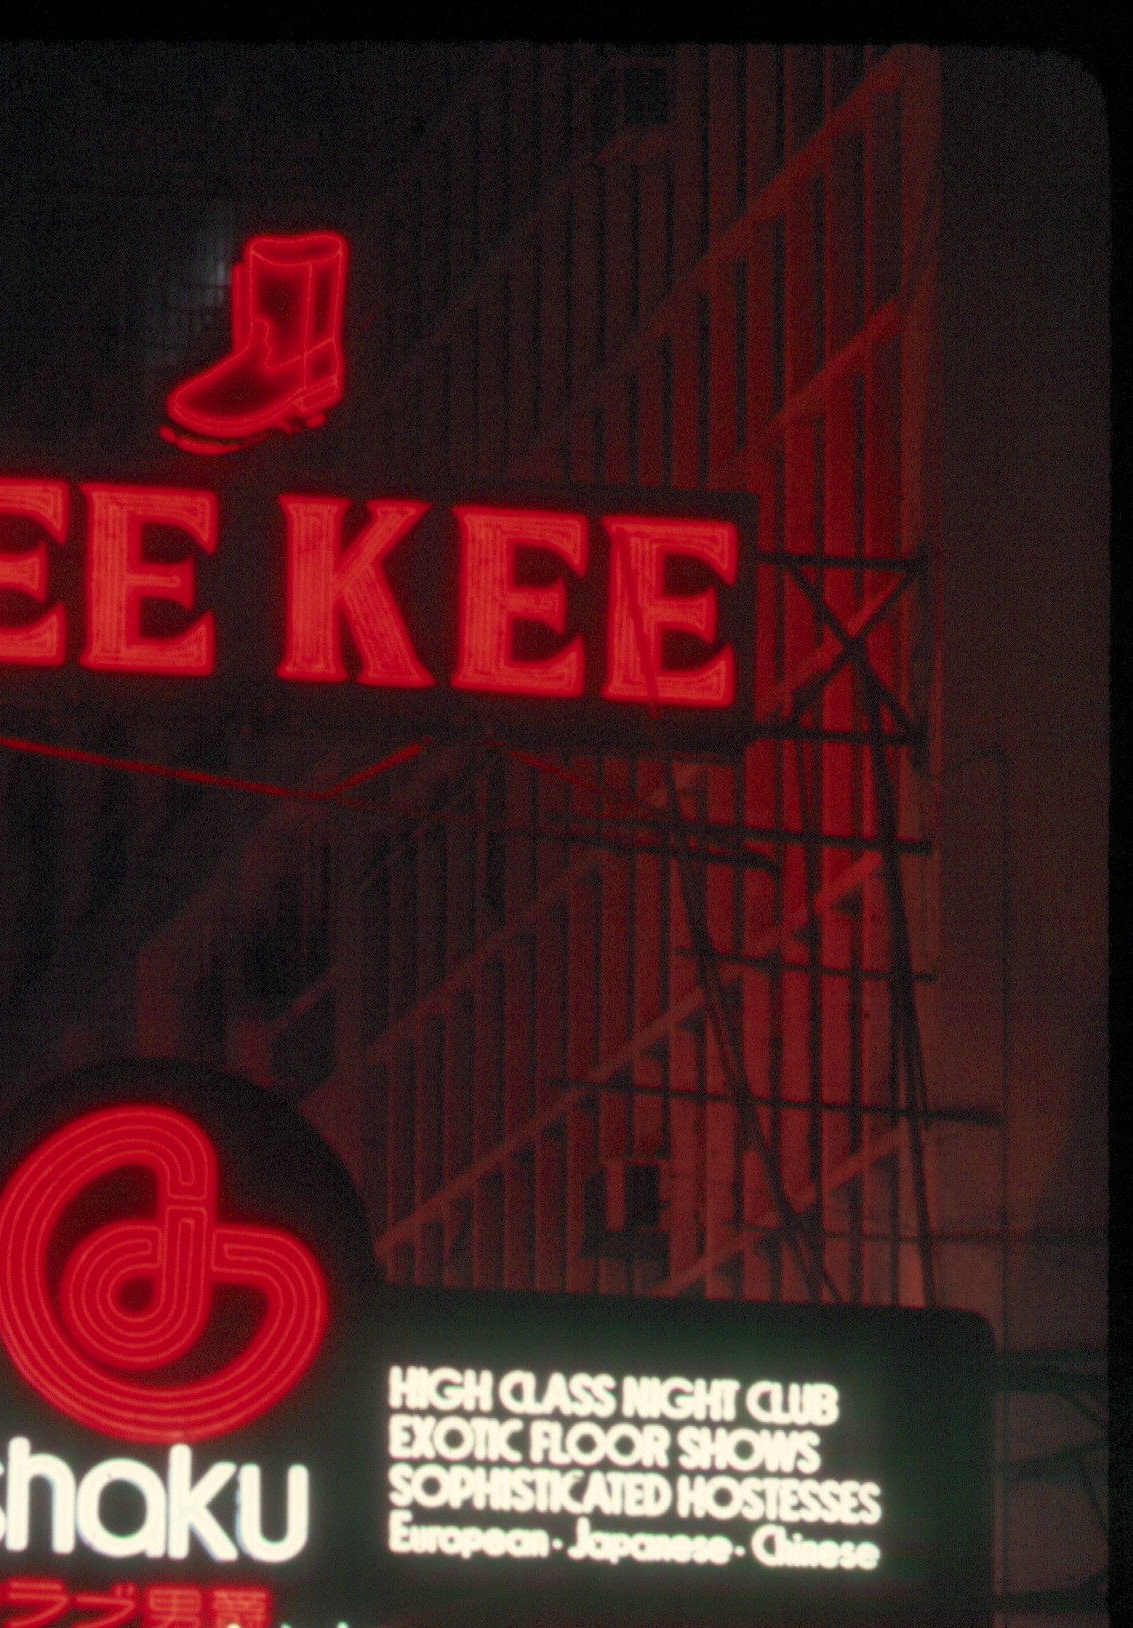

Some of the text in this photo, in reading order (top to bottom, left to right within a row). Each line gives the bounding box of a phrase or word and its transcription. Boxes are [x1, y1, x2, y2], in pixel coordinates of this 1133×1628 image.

[276, 492, 738, 708] KEE
[388, 1365, 840, 1426] HIGH CLASS NIGHT CLUB
[388, 1414, 822, 1475] EXOTIC FLOOR SHOWS
[388, 1463, 883, 1525] SOPHISTICATED HOSTESSES
[388, 1510, 882, 1570] European Japanese Chinese
